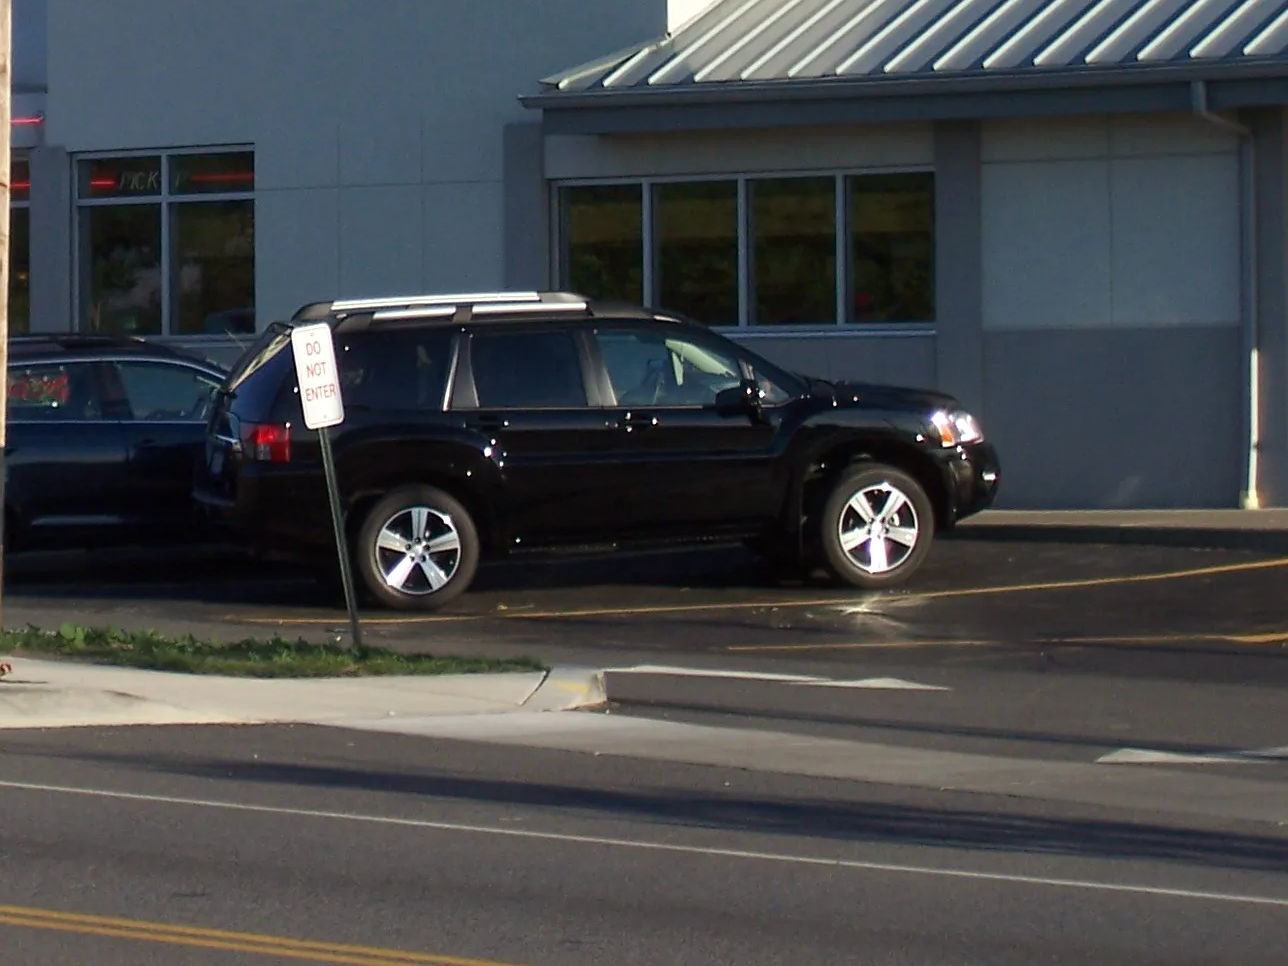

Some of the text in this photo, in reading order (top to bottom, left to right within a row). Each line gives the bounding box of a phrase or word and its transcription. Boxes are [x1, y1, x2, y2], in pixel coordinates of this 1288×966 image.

[305, 341, 321, 356] DO
[306, 362, 326, 378] NOT
[305, 384, 336, 402] ENTER
